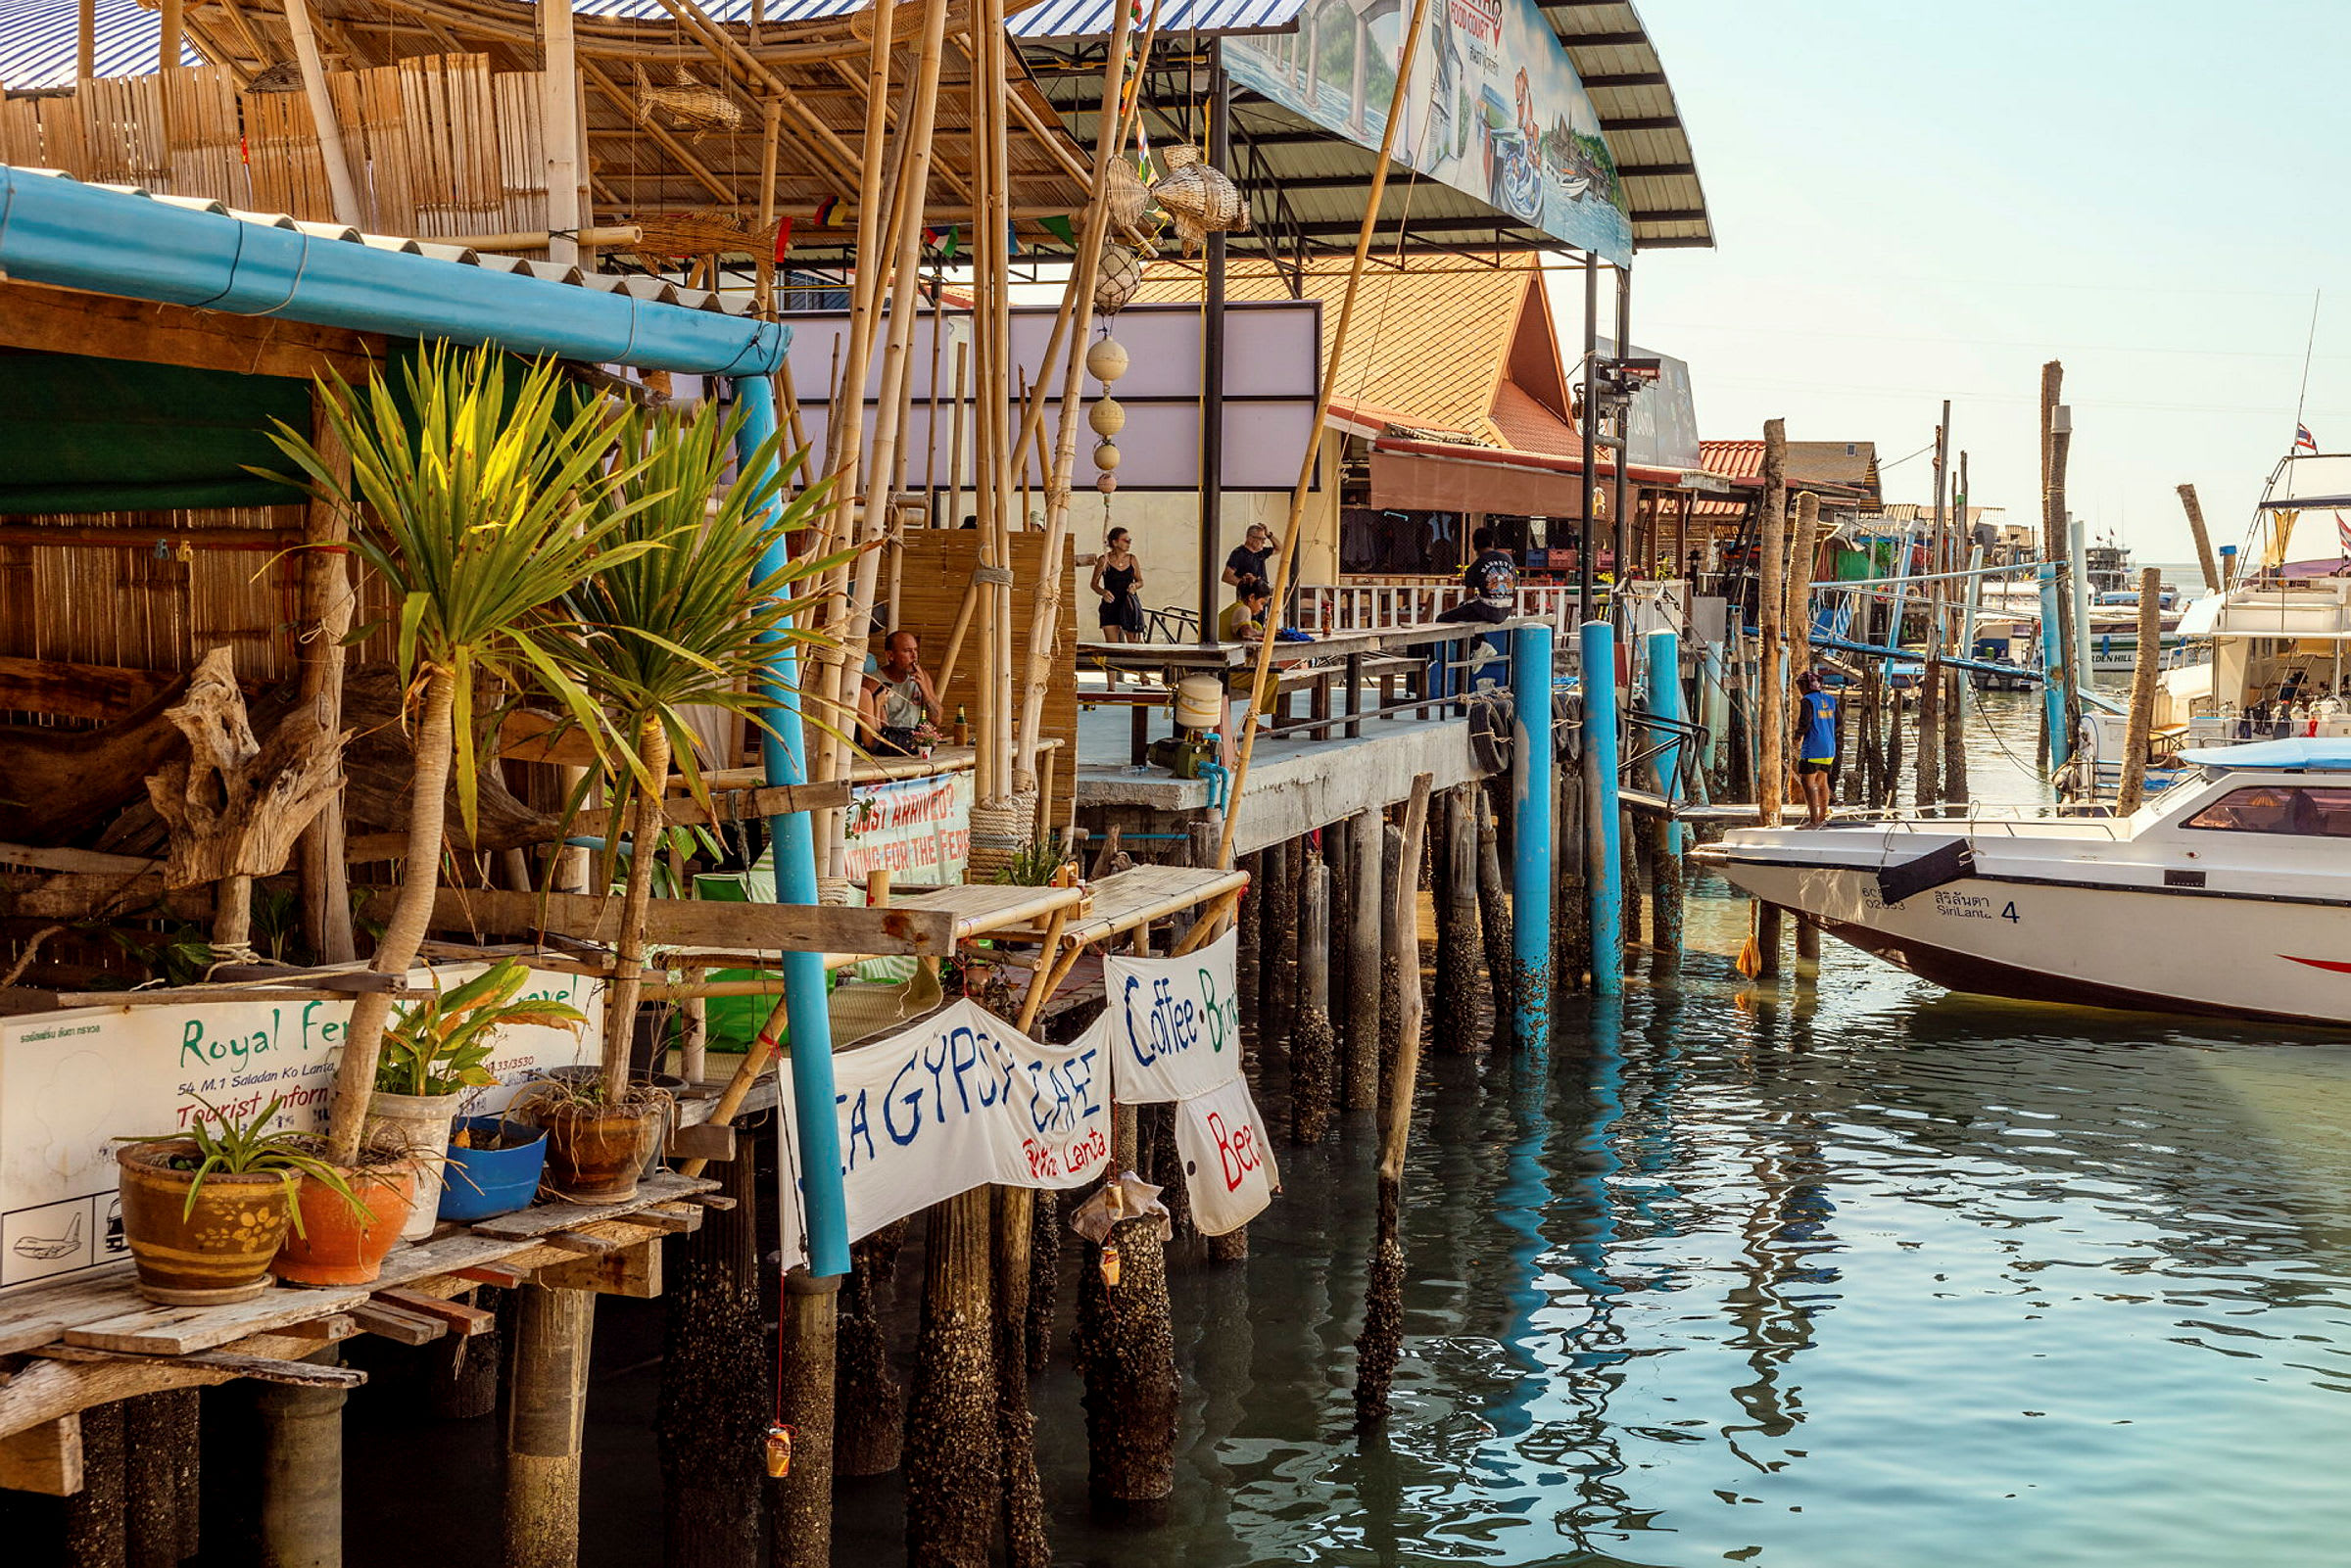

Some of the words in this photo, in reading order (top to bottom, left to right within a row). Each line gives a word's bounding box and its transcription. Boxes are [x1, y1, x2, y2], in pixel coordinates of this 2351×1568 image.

[1451, 1, 1467, 30] FOOD
[1467, 12, 1490, 43] COURT
[2114, 654, 2133, 663] HILL
[852, 799, 887, 834] JUST
[891, 784, 956, 829] ARRIVED?
[884, 840, 910, 871] FOR
[910, 835, 937, 867] THE
[2001, 900, 2020, 924] 4
[180, 1008, 281, 1073] Royal
[1124, 974, 1198, 1068] Coffee
[177, 1084, 195, 1096] 54
[231, 1073, 278, 1088] Saladan
[283, 1067, 298, 1079] Ko
[176, 1090, 263, 1128] Tourist
[1063, 1125, 1107, 1173] Lanta
